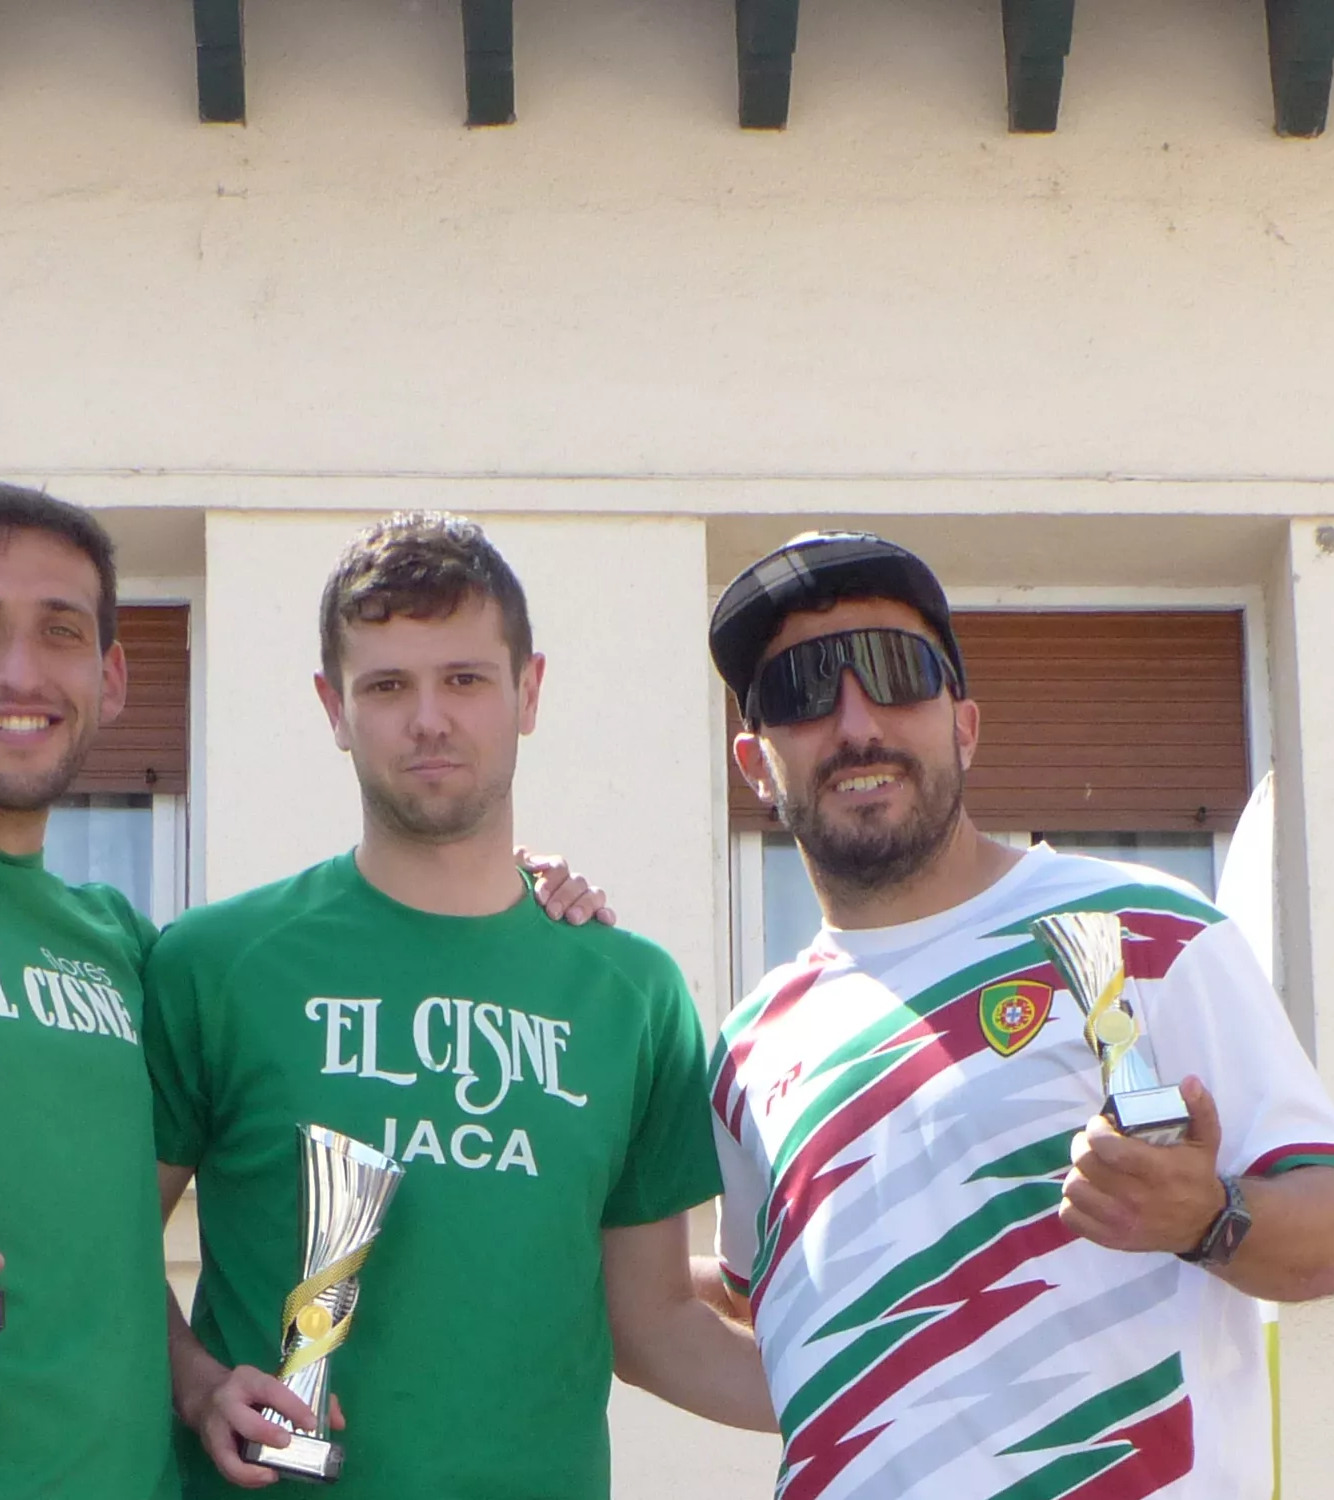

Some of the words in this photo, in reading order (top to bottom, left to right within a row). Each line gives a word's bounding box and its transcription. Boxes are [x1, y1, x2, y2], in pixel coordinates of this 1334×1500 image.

[24, 966, 138, 1045] CISNE
[305, 997, 417, 1086] EL
[413, 997, 588, 1115] CISNE
[382, 1118, 539, 1177] JACA
